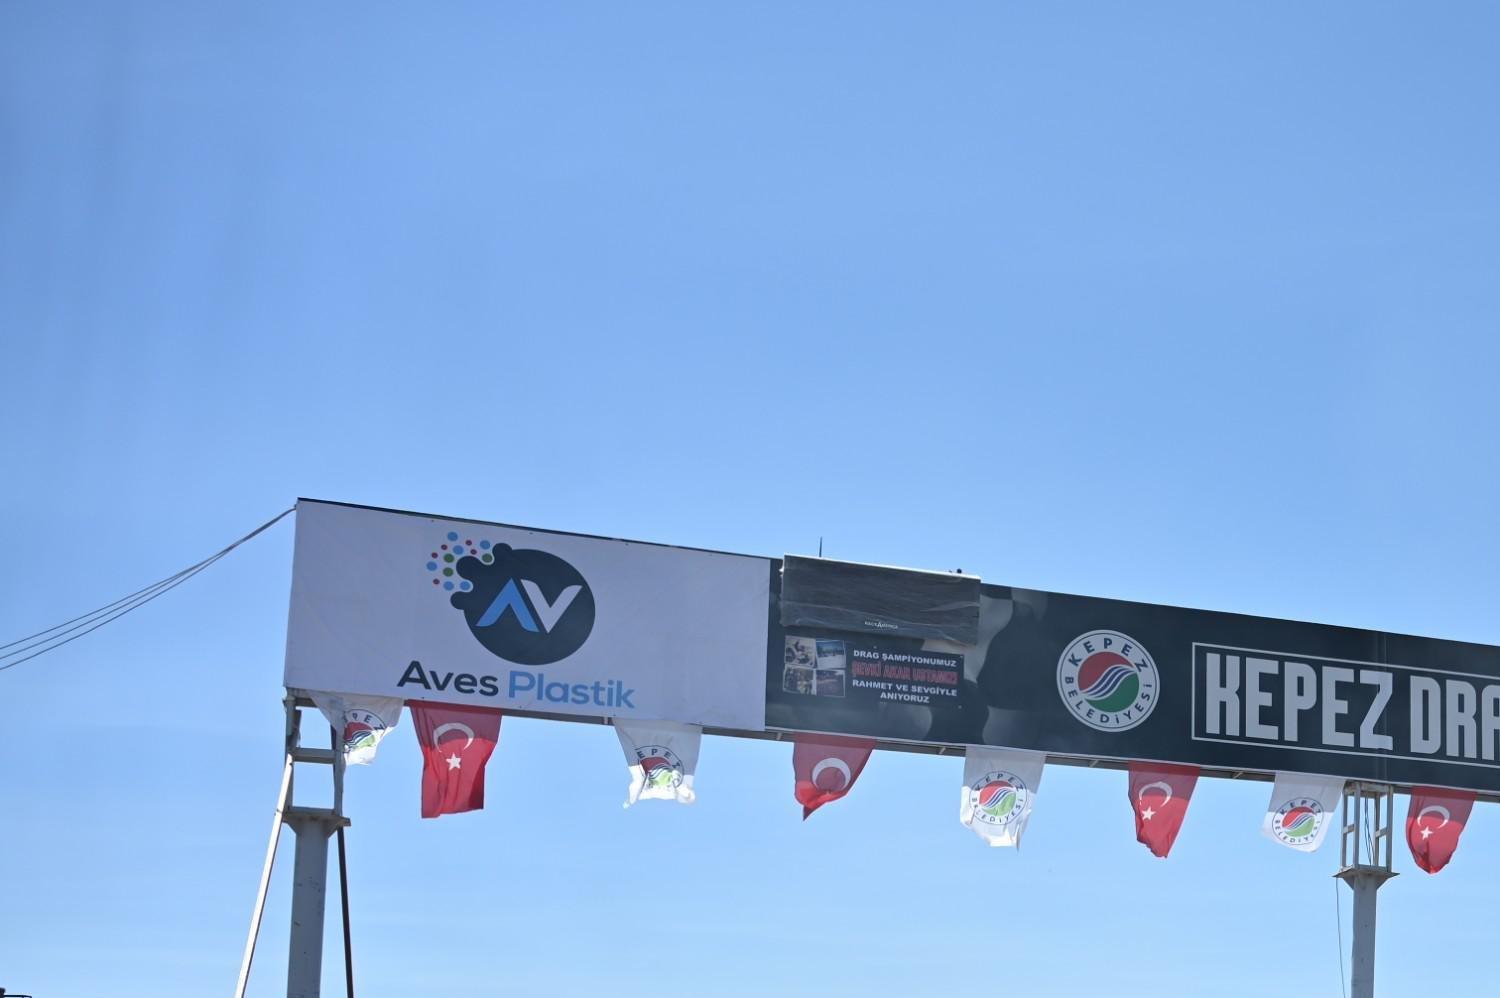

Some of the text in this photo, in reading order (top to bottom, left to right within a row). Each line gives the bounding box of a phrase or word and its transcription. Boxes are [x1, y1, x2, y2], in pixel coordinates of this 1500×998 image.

[853, 649, 958, 668] DRAG ŞAMPİYONUMUZ
[1068, 637, 1149, 673] KEPEZ
[396, 660, 636, 709] Aves Plastik
[852, 679, 958, 697] RAHMET VE SEVGİYLE
[880, 691, 931, 704] ANIYORUZ
[1064, 676, 1153, 725] BELEDİYESİ
[1205, 652, 1394, 752] KEPEZ
